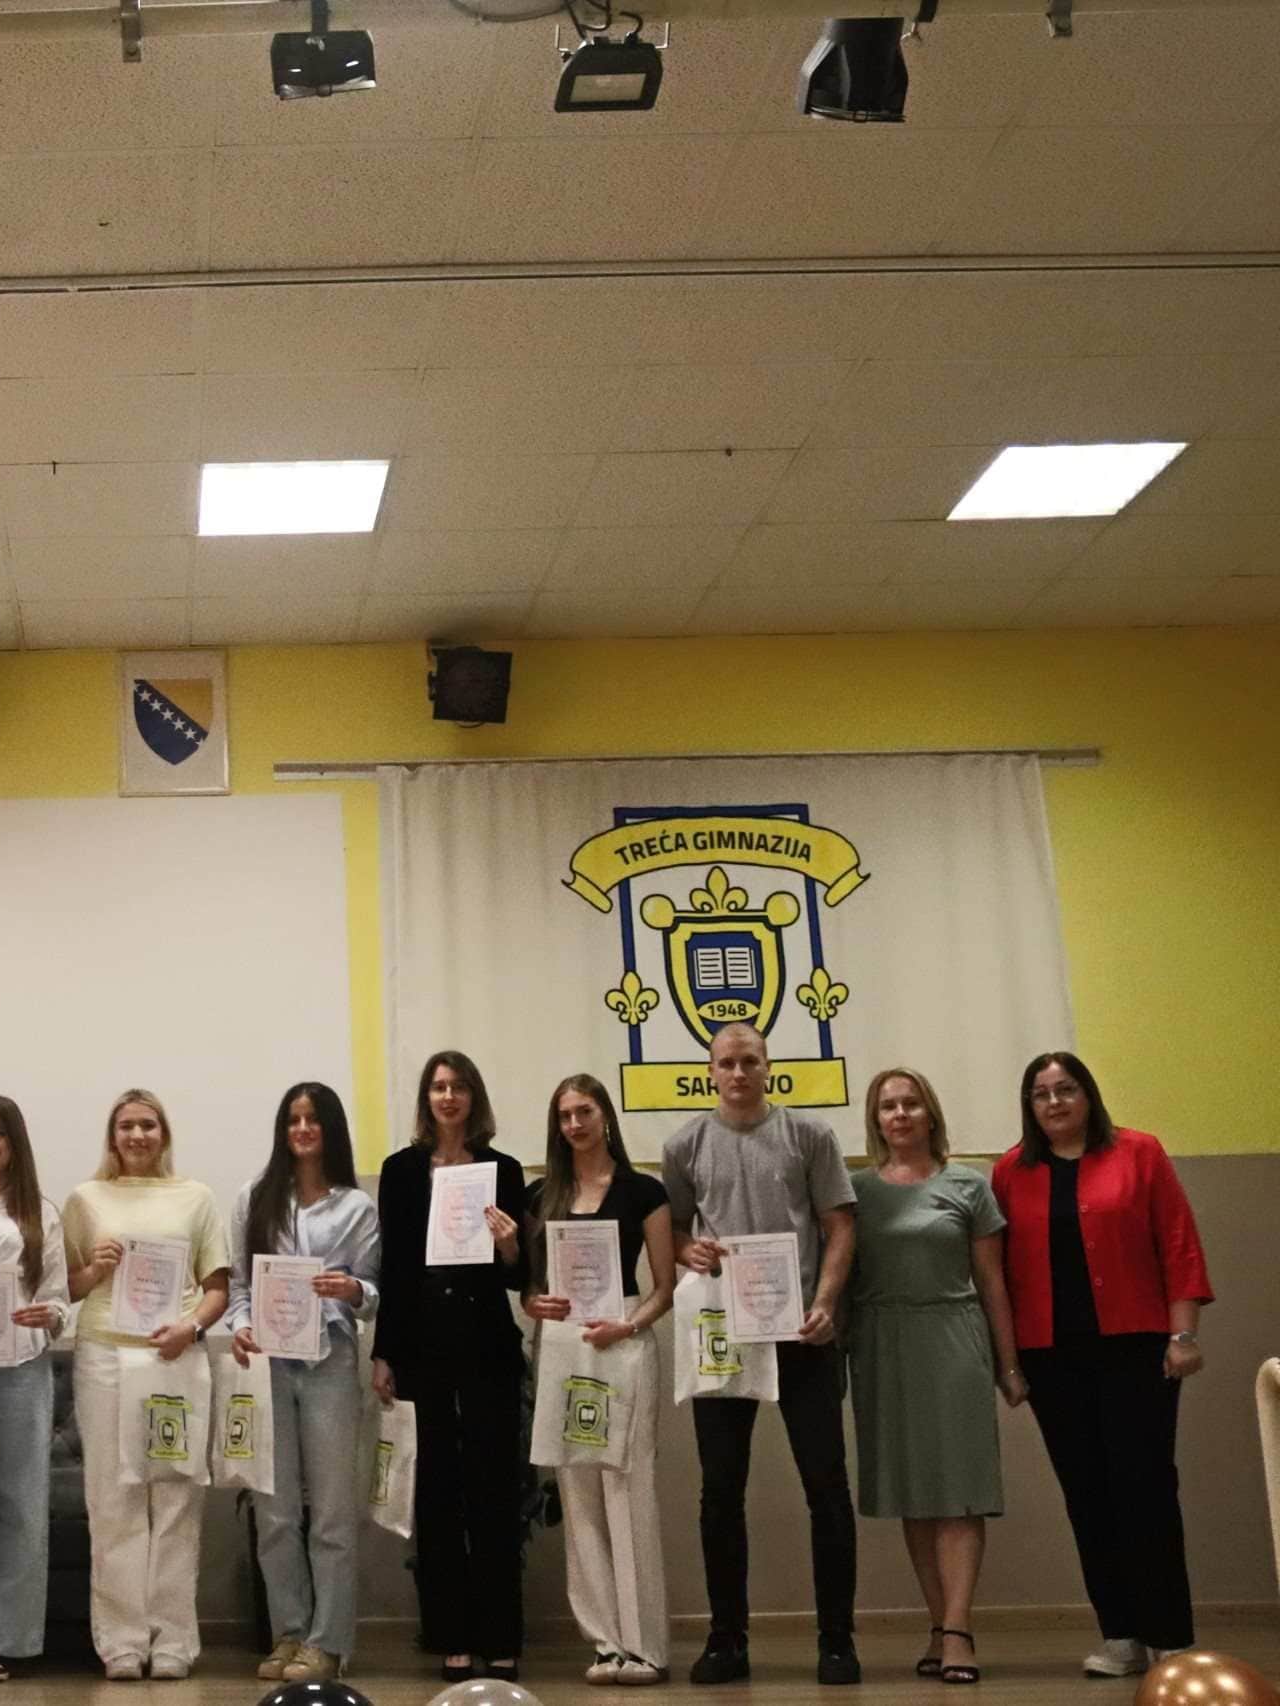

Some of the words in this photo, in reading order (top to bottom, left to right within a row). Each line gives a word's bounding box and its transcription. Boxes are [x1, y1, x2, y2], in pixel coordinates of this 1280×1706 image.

[615, 830, 689, 866] TREĆA
[692, 831, 812, 863] GIMNAZIJA
[707, 1003, 748, 1018] 1948
[676, 1074, 793, 1097] SARVO
